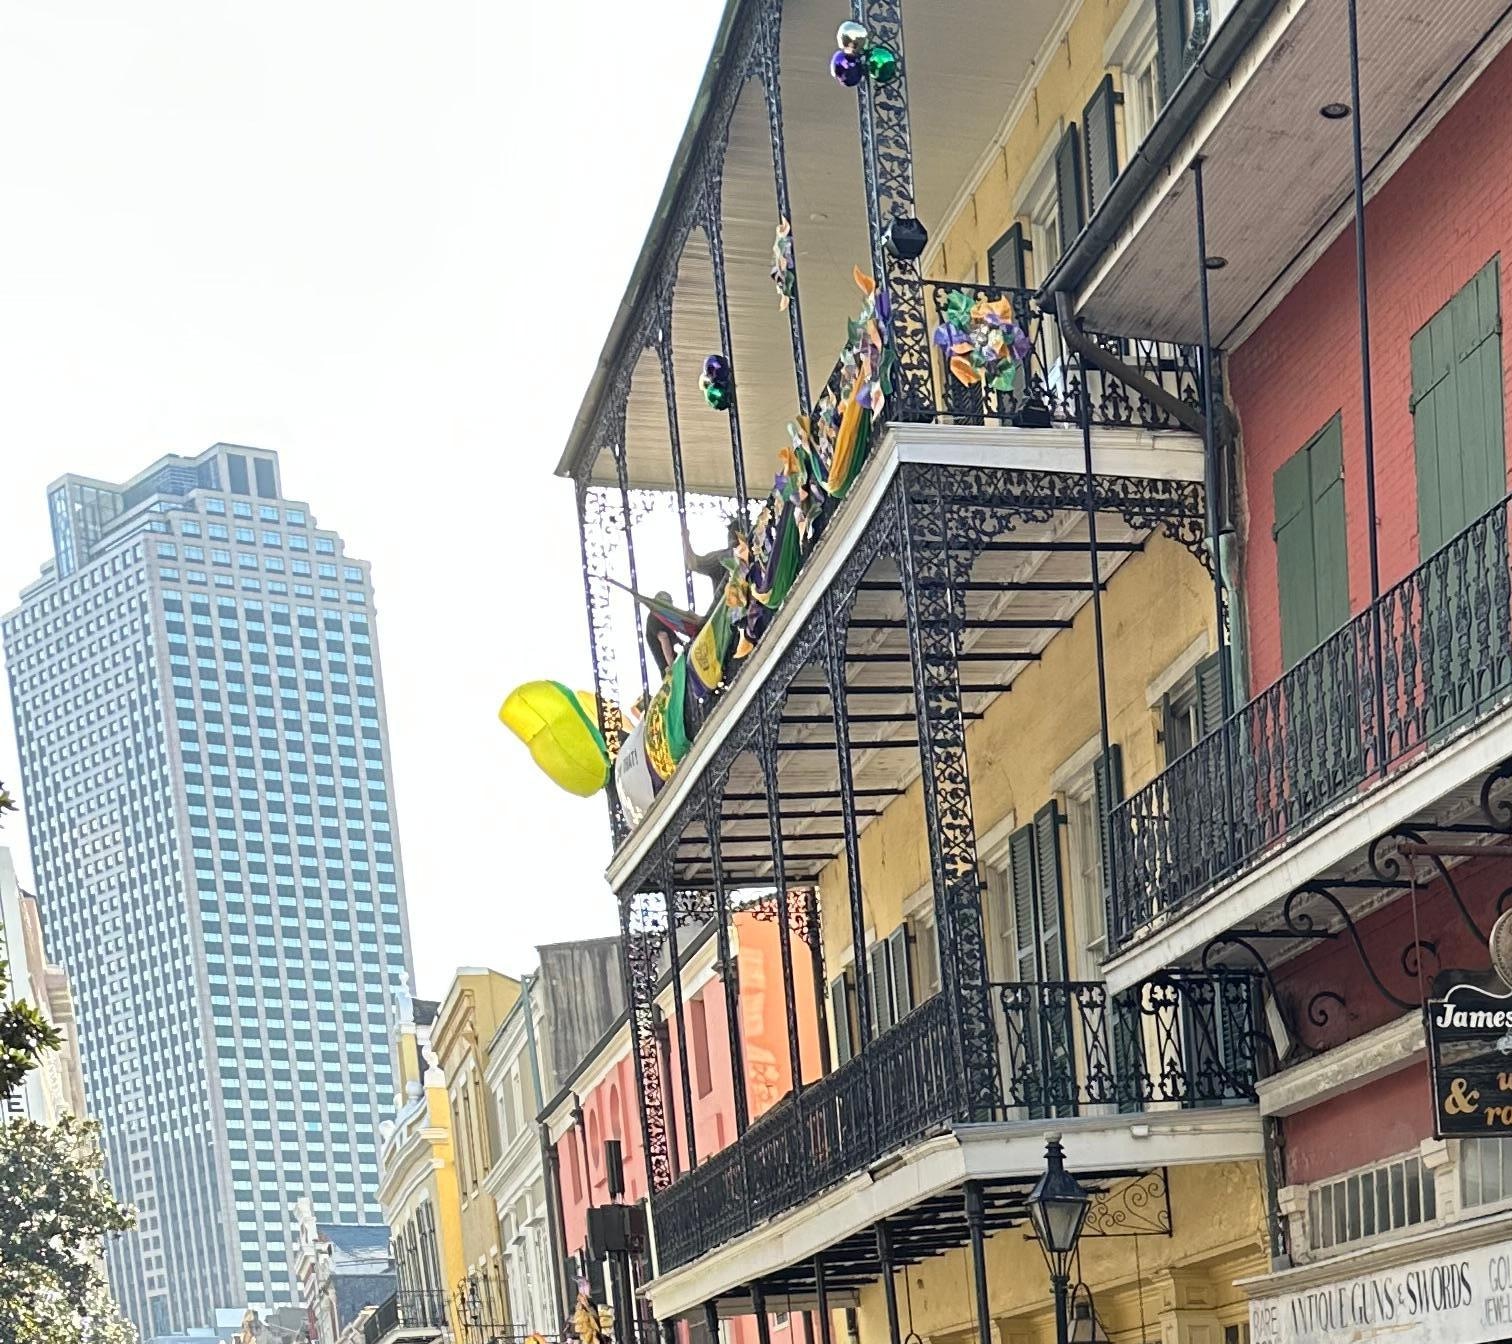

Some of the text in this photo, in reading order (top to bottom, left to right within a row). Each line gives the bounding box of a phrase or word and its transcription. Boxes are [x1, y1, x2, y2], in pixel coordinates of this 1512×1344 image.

[1444, 1078, 1480, 1115] &
[1253, 1307, 1278, 1340] RARE
[1291, 1286, 1349, 1336] ANTIQUE
[1351, 1276, 1395, 1326] GUNS
[1406, 1261, 1472, 1316] SWORDS
